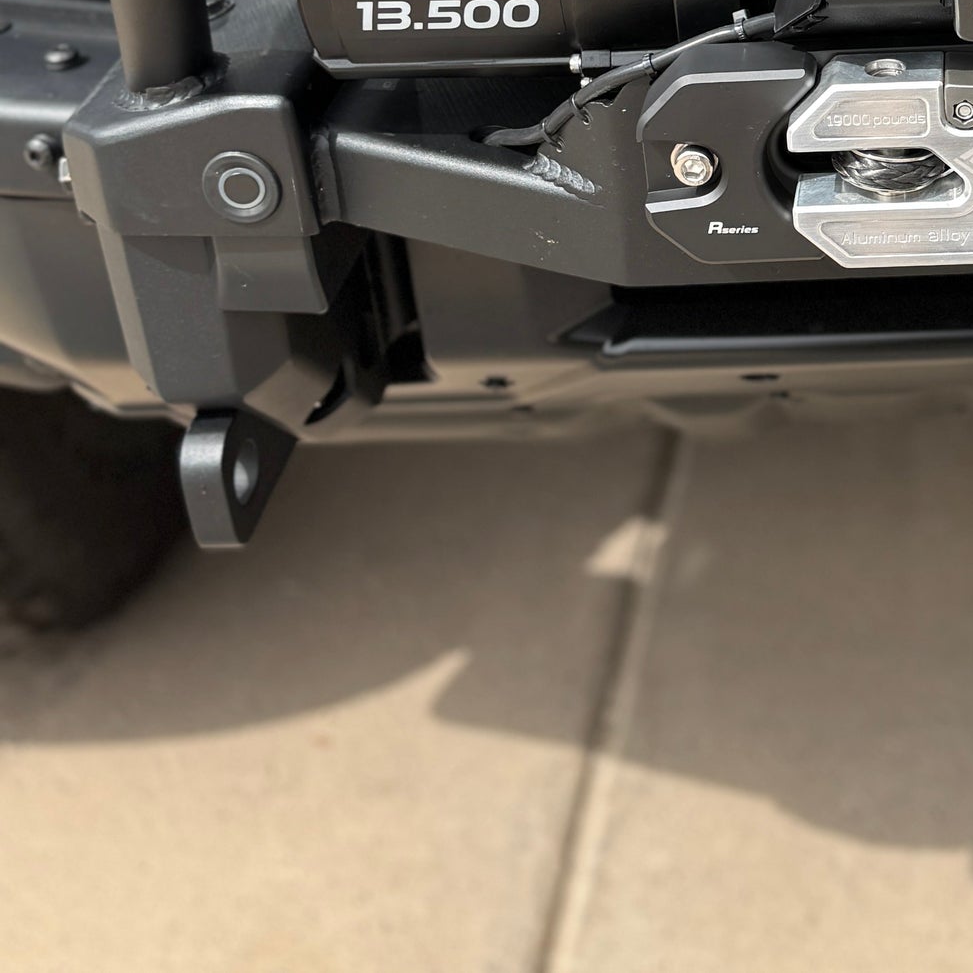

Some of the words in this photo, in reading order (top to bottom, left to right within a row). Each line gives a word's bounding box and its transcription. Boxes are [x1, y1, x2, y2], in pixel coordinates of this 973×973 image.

[826, 114, 871, 127] 19000
[873, 114, 926, 129] pounds
[841, 231, 921, 246] Aluminum
[928, 228, 970, 246] alloy
